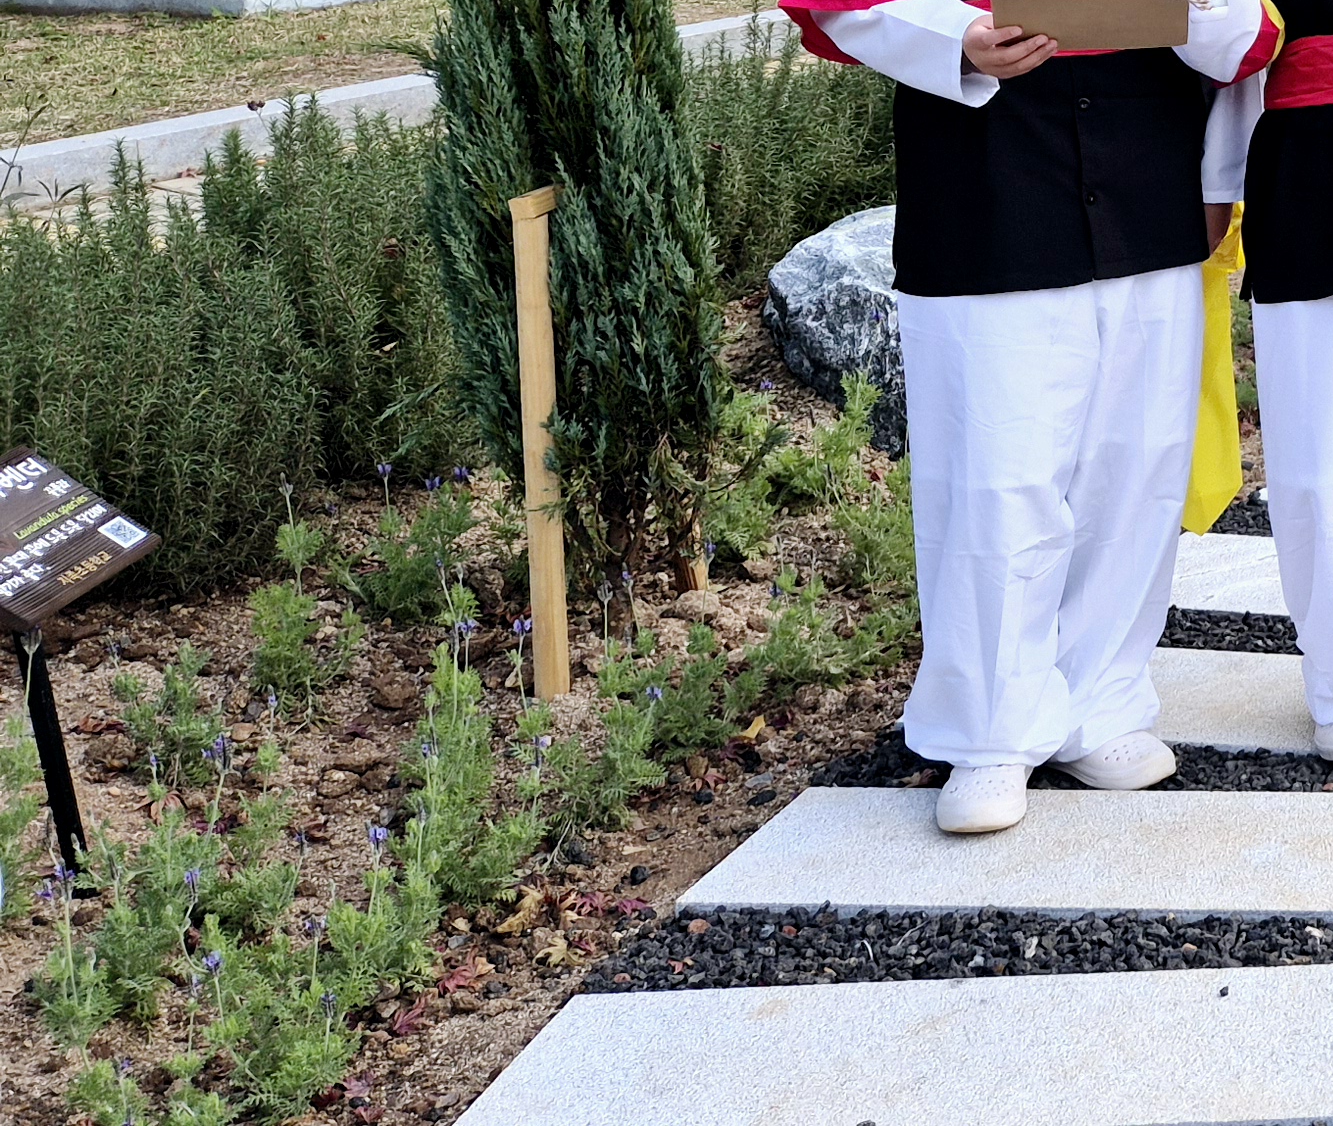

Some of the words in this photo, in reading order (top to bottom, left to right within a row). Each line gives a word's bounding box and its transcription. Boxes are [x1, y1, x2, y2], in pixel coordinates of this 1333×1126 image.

[0, 457, 48, 498] 벤더
[13, 508, 59, 540] Lavandula
[57, 494, 89, 517] species
[57, 551, 112, 585] 지족초등학교
